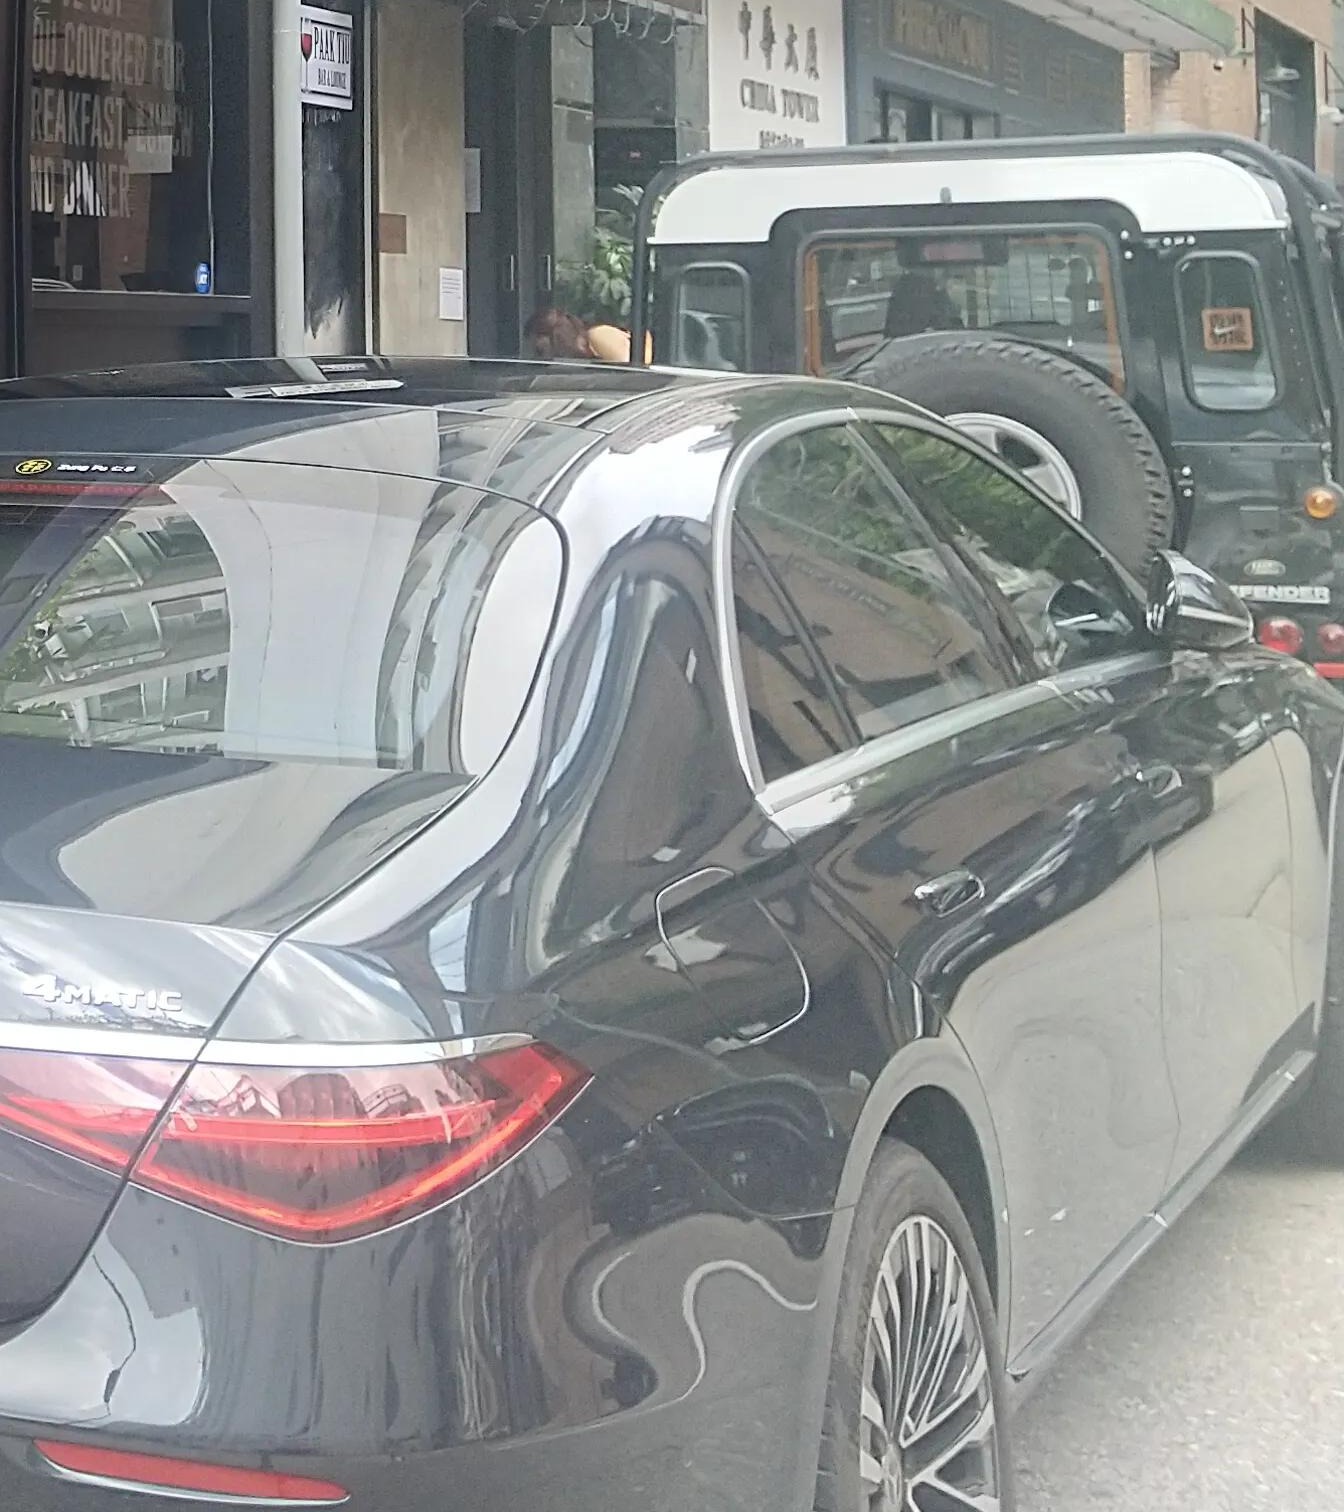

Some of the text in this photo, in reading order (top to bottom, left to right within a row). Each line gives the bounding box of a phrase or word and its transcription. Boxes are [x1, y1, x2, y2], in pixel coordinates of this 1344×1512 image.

[31, 20, 187, 93] OU COVERED FOR
[313, 26, 351, 65] PAAK TIU
[740, 78, 777, 114] CHINA
[30, 153, 56, 215] ND
[1229, 584, 1330, 604] FENDER
[21, 972, 184, 1013] 4MATIC
